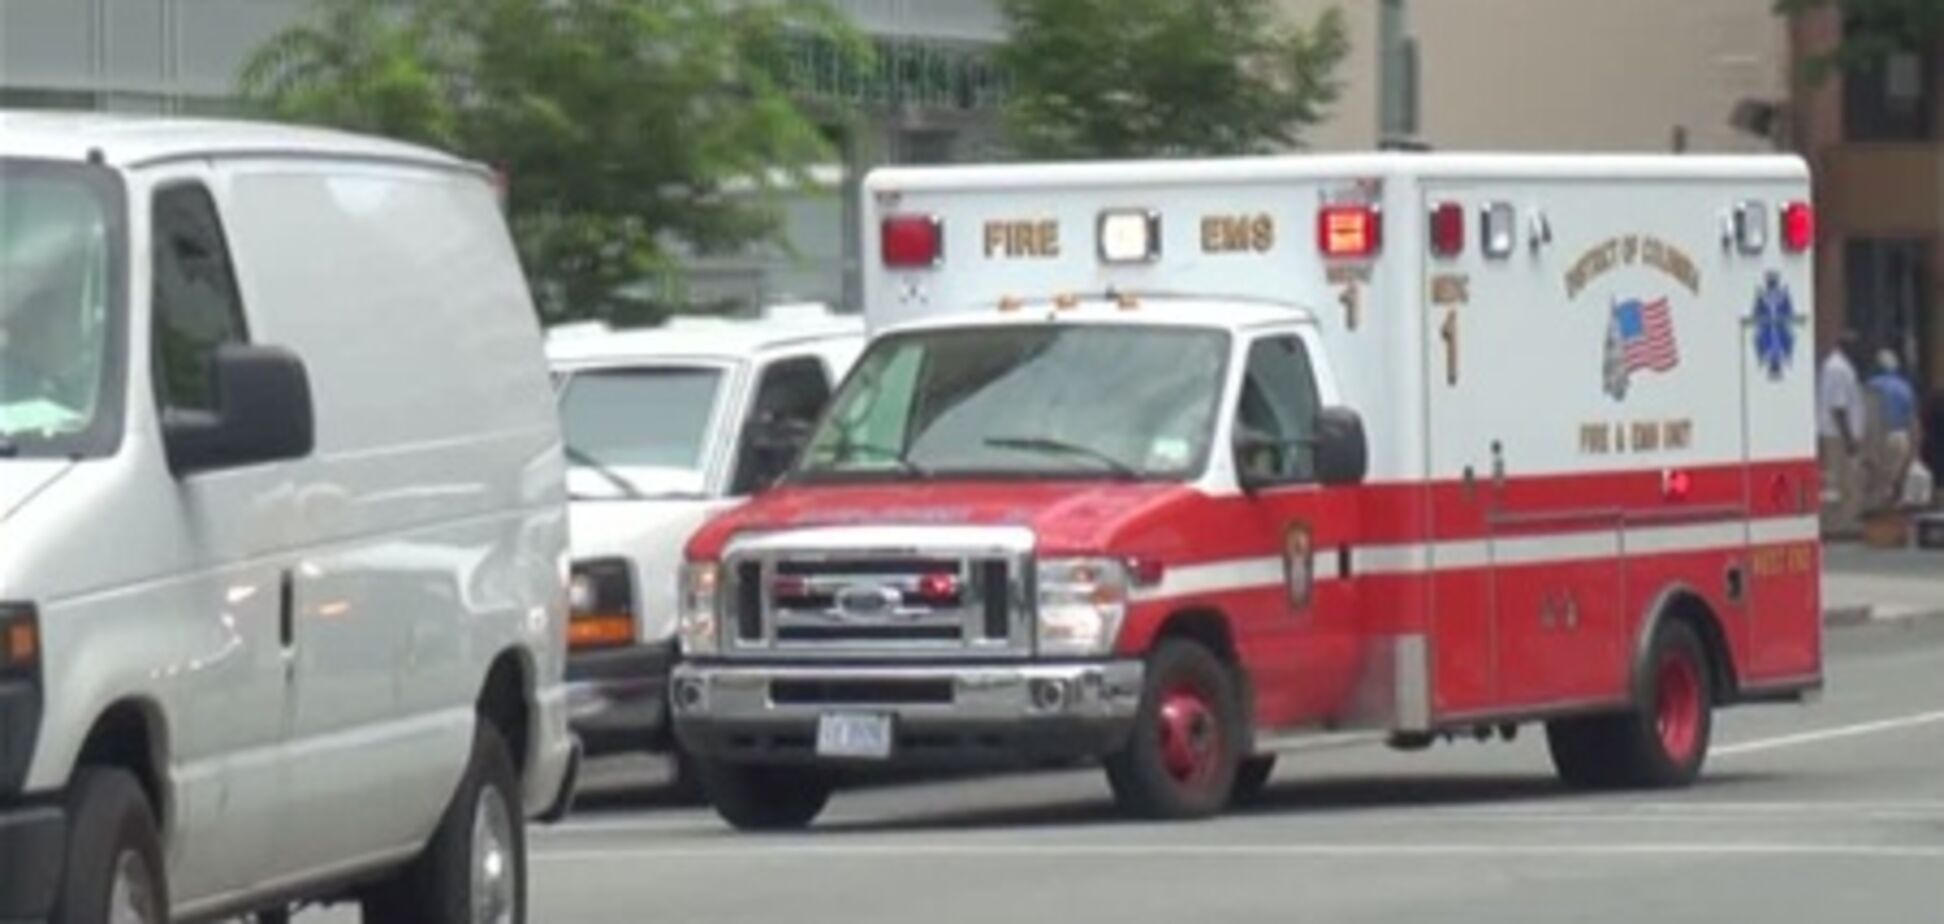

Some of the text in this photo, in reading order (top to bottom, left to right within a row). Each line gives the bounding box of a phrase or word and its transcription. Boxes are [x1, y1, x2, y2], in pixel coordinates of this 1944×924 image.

[984, 220, 1061, 258] FIRE
[1200, 213, 1274, 254] EMS
[1565, 237, 1617, 301] DISTRICT
[1623, 234, 1638, 264] OF
[1339, 284, 1357, 333] 1
[1441, 310, 1458, 387] 1
[1580, 422, 1609, 453] FIRE
